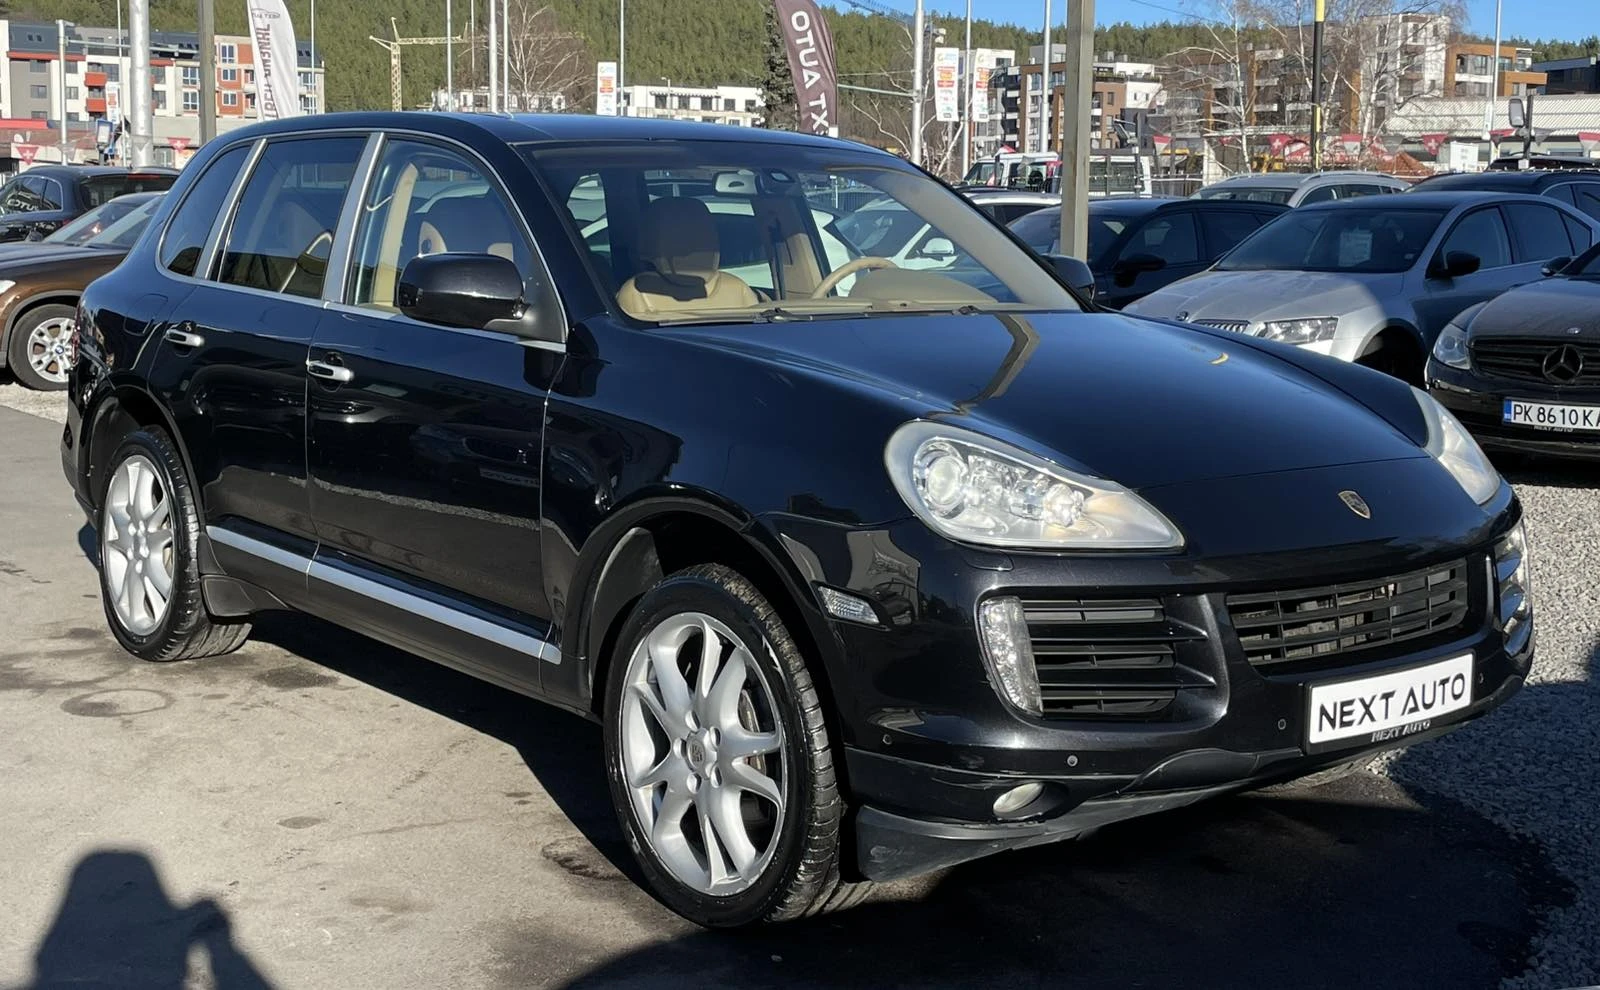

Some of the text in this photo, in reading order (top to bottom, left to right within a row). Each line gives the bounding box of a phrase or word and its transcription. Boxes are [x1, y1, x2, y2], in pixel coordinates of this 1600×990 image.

[1513, 404, 1533, 422] PK
[1537, 406, 1579, 426] 8610
[1318, 672, 1466, 733] NEXT AUTO
[1371, 720, 1431, 742] NEXT AUTO
